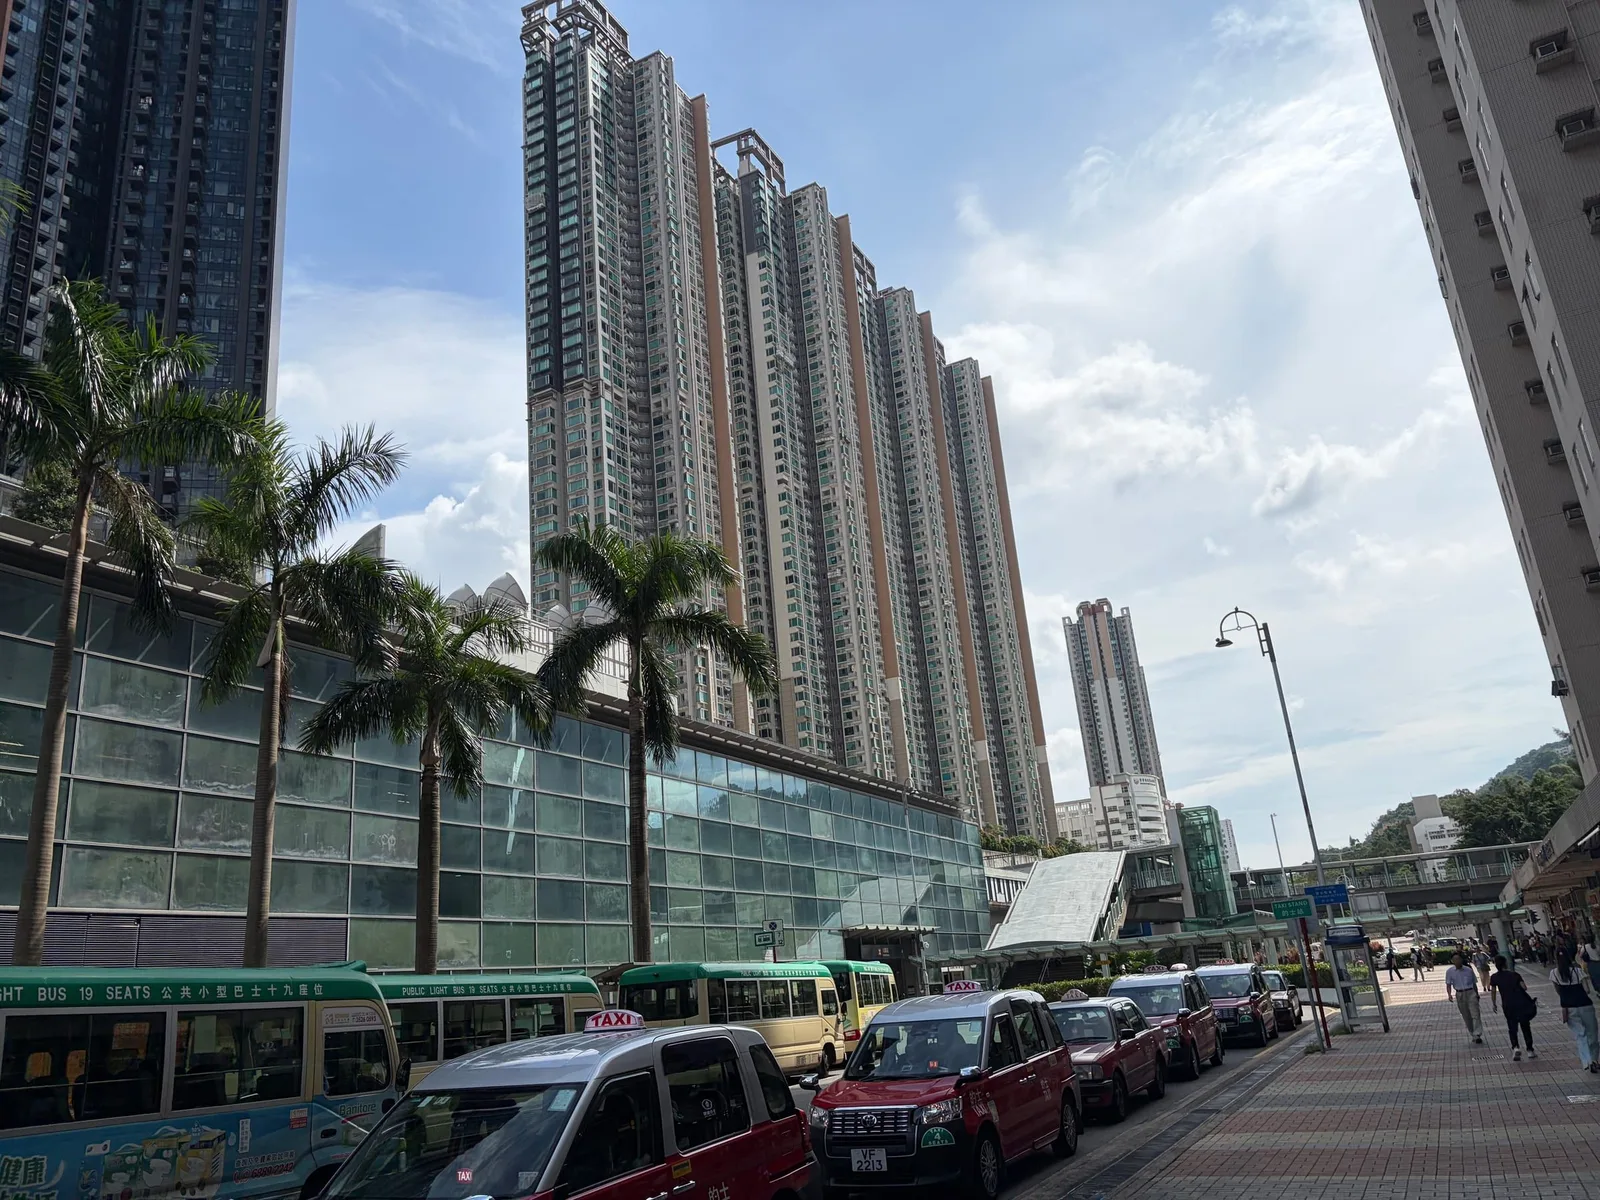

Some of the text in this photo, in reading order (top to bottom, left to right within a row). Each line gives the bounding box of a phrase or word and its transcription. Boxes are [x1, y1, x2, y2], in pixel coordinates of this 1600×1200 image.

[0, 983, 323, 1002] HT BUS 19 SEATS 公共小型巴士十九座位
[402, 987, 426, 996] PUBLIC
[429, 986, 448, 995] LIGHT
[453, 985, 465, 994] BUS
[479, 985, 498, 994] SEATS
[947, 981, 976, 991] TAXI
[592, 1012, 631, 1027] TAXI
[339, 1103, 377, 1116] Banitore
[972, 1102, 989, 1117] TAXI
[861, 1149, 876, 1160] VF
[2, 1156, 46, 1187] 健康
[856, 1160, 883, 1171] 2213
[457, 1170, 473, 1181] TAXI
[708, 1182, 731, 1200] 的士
